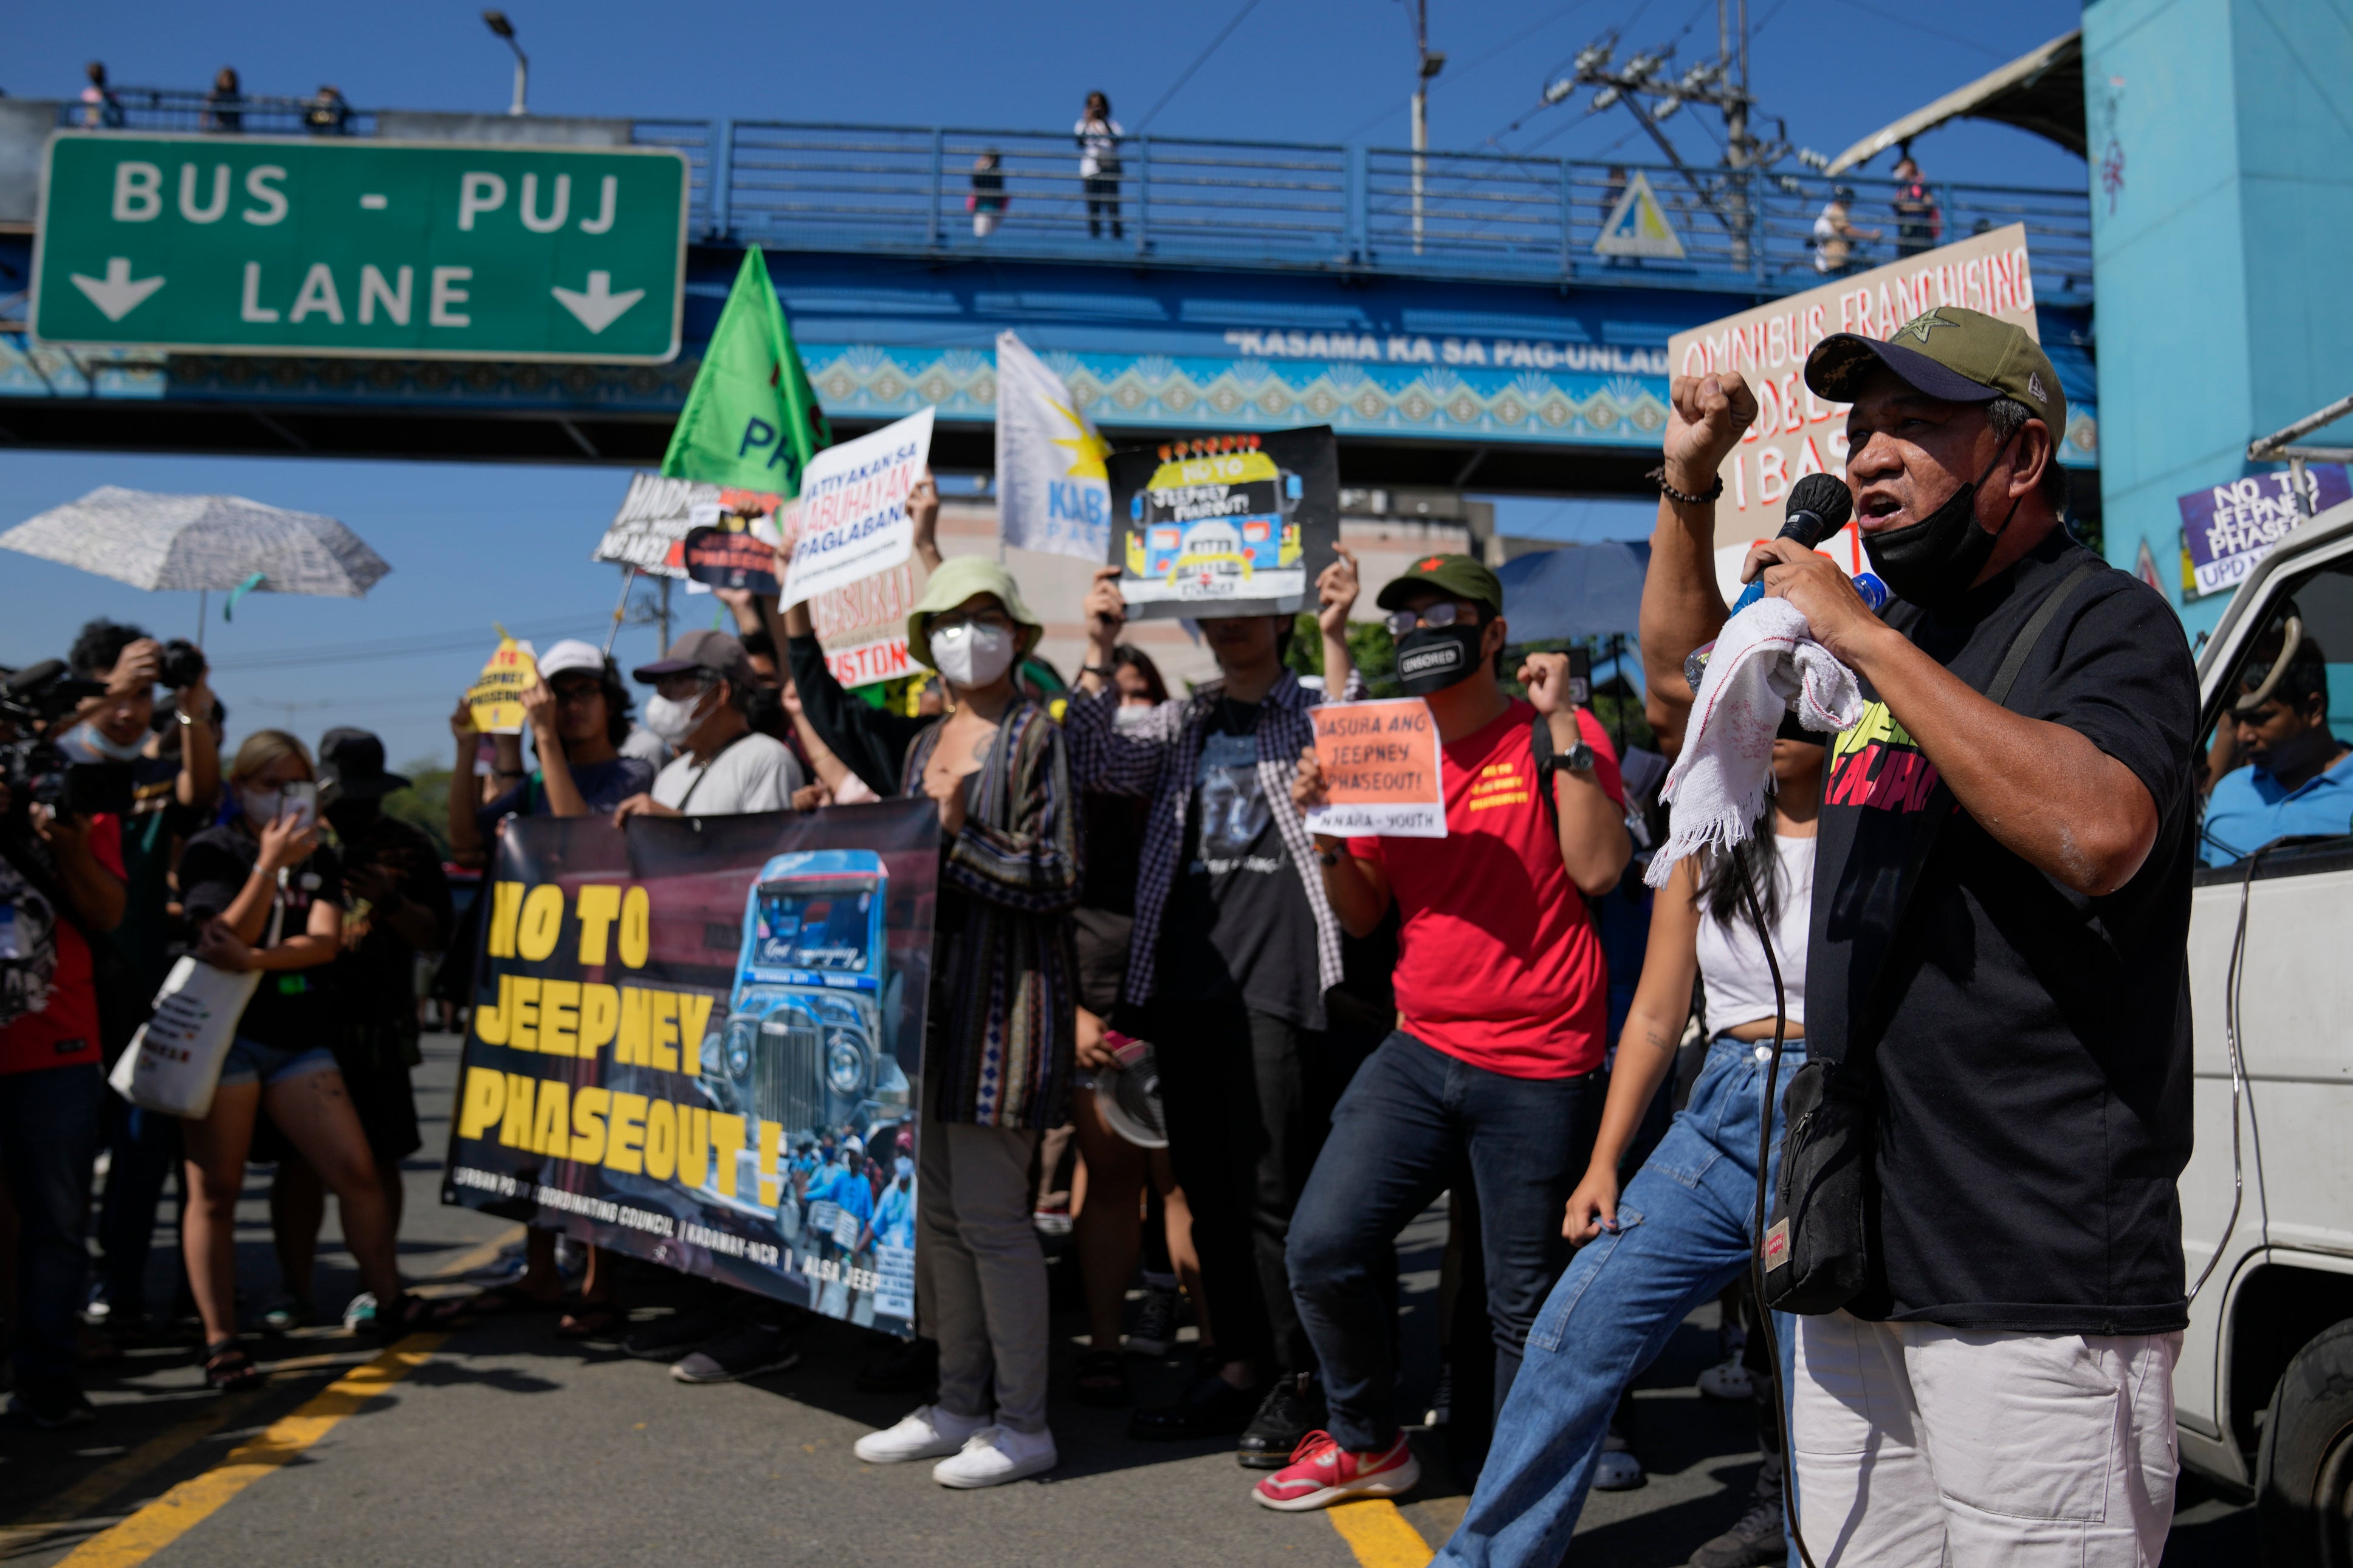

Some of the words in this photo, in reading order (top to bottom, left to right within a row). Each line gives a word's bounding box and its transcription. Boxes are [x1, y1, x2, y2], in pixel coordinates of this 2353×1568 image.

[111, 162, 290, 227] BUS
[458, 171, 619, 234] PUJ
[241, 261, 474, 328] LANE
[1682, 304, 1825, 377] OMNIBUS
[1840, 246, 2034, 341] FRANCHISING
[1387, 334, 1434, 363] KA
[1441, 336, 1486, 366] SA
[1181, 460, 1212, 483] NO
[1213, 457, 1244, 479] TO
[2213, 477, 2260, 509] NO
[1402, 649, 1457, 673] CENSORED
[1318, 716, 1381, 738] BASURA
[1387, 713, 1426, 733] ANG
[1331, 743, 1410, 766] JEEPNEY
[1327, 771, 1422, 791] PHASEOUT!
[1386, 812, 1434, 827] YOUTH
[488, 880, 565, 961] NO
[577, 884, 650, 968] TO
[475, 974, 713, 1077] JEEPNEY
[458, 1066, 783, 1208] PHASEOUT!
[453, 1166, 499, 1193] URBAN
[531, 1183, 619, 1224] COORDINATING
[618, 1205, 675, 1238] COUNCIL
[802, 1255, 840, 1282] ALSA
